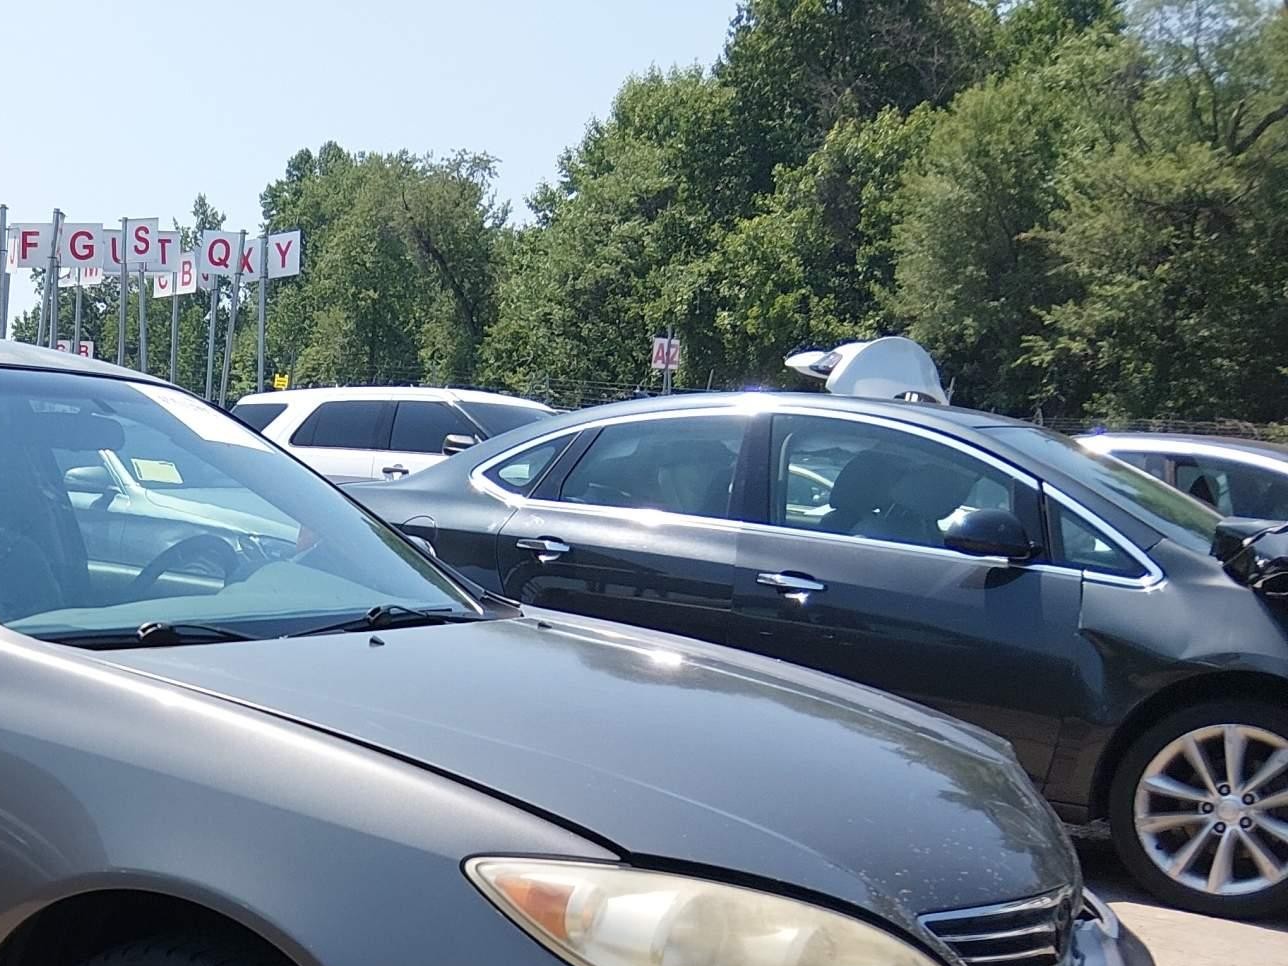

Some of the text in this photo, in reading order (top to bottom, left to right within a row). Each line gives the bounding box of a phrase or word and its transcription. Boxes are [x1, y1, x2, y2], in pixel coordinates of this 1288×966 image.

[21, 230, 40, 260] F
[69, 230, 95, 261] G
[133, 225, 150, 255] S
[157, 238, 172, 265] T
[207, 238, 231, 269] Q
[274, 239, 294, 269] Y
[181, 260, 193, 287] B
